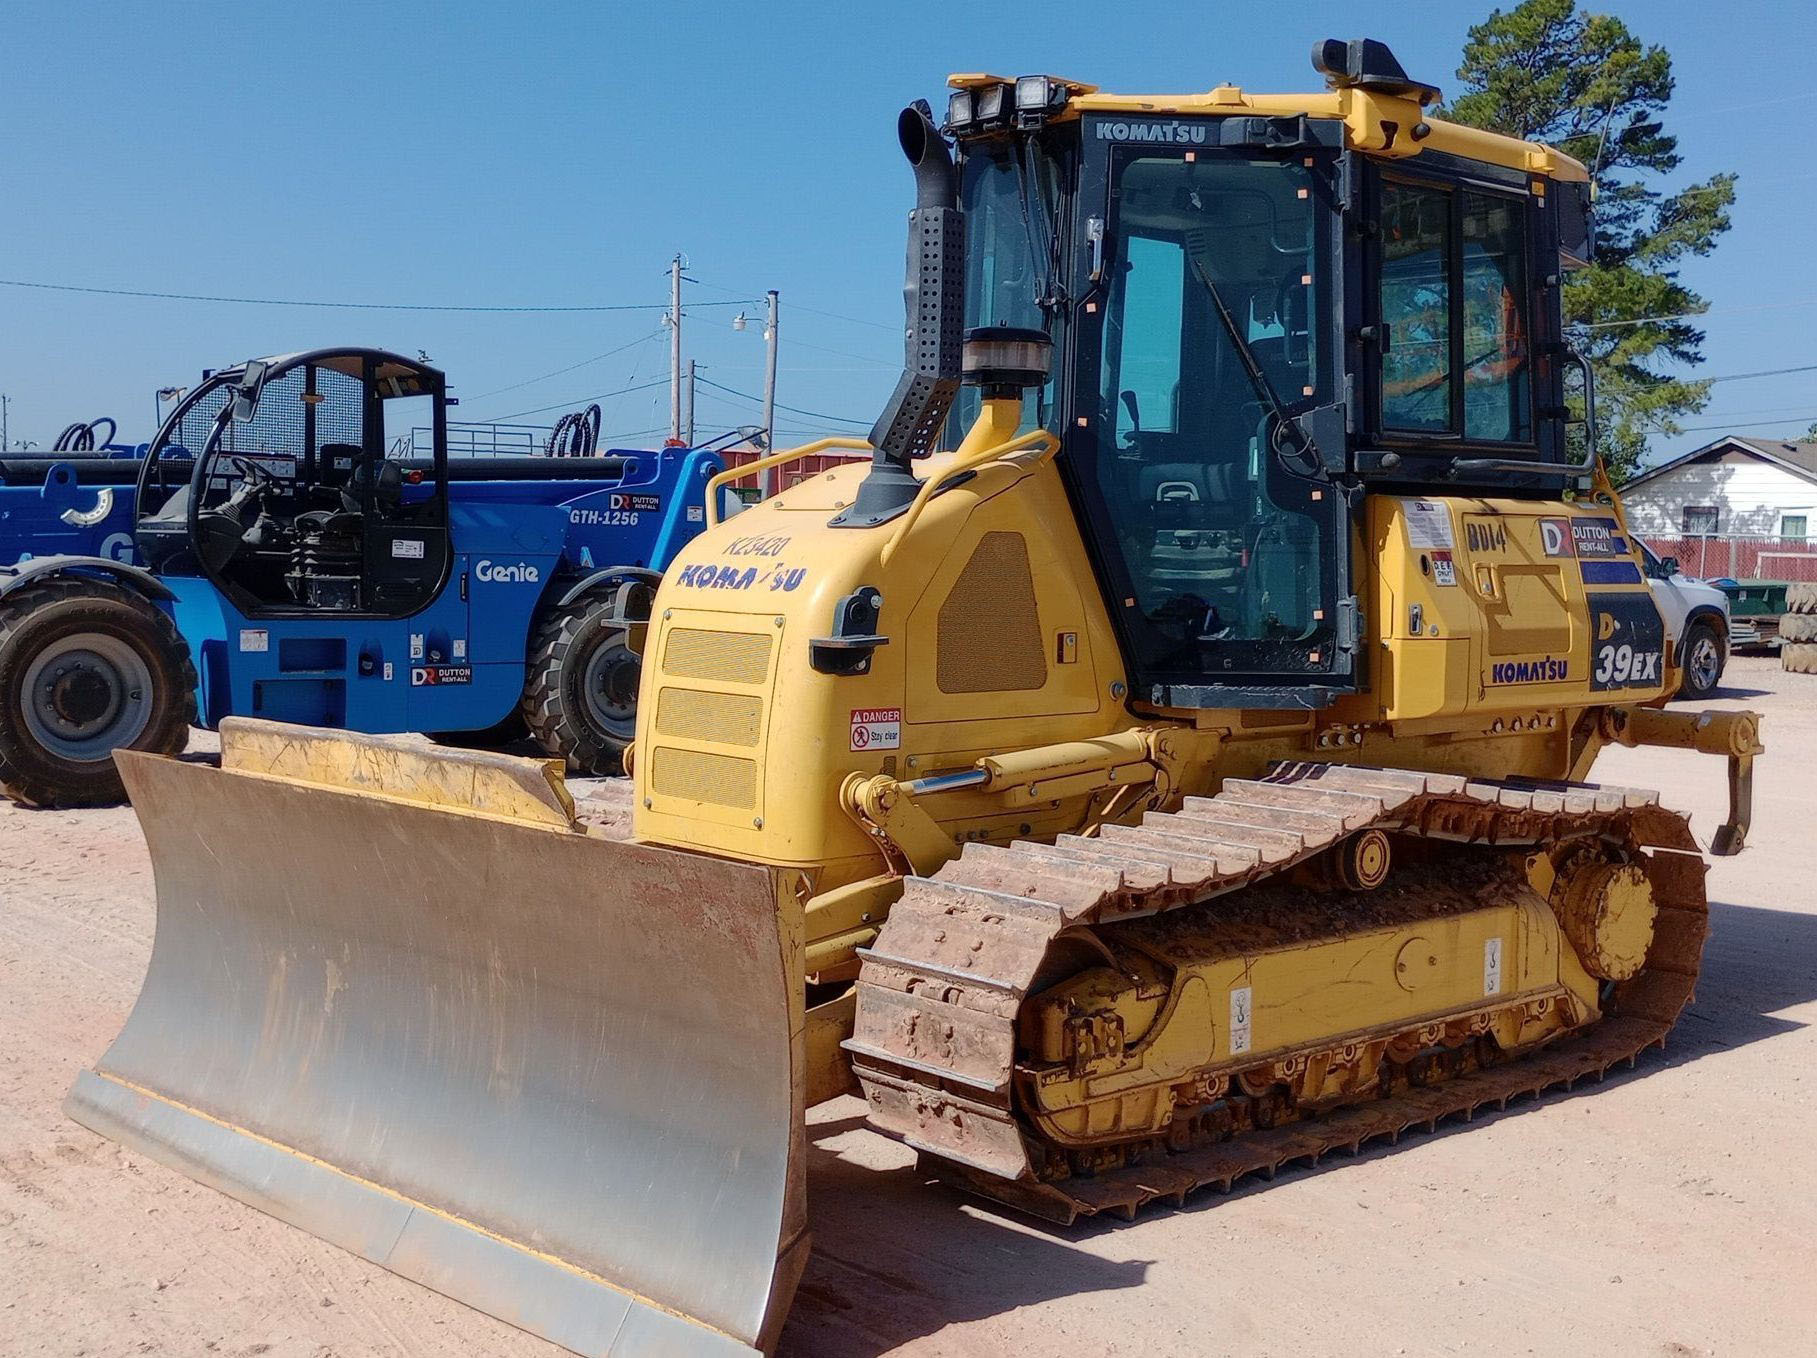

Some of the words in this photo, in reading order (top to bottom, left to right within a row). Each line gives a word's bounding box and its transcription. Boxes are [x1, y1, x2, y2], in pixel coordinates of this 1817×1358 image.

[1096, 121, 1206, 144] KOMATSU
[632, 496, 659, 504] DUTTON
[569, 509, 639, 526] GTH-1256
[1573, 526, 1610, 540] DUTTON
[1578, 542, 1609, 552] RENT-ALL
[475, 560, 539, 583] Genie
[438, 668, 471, 677] DUTTON
[1492, 655, 1568, 684] KOMATSU
[862, 711, 900, 722] DANGER
[871, 731, 883, 742] Stay
[885, 731, 898, 740] clear
